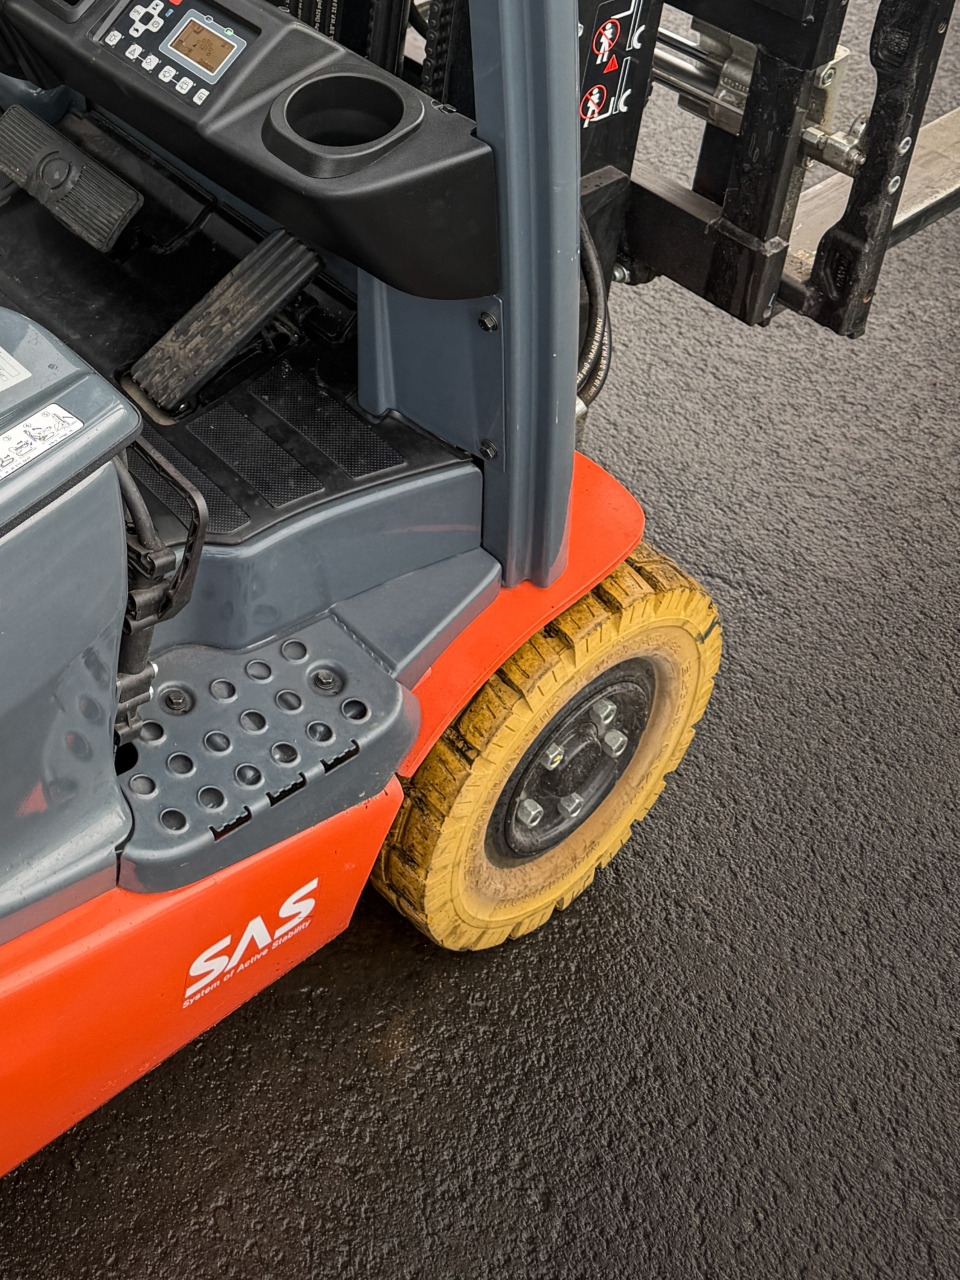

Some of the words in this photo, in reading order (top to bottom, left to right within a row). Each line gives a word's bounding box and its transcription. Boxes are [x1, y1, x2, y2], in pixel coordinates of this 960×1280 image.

[182, 980, 220, 1009] System
[223, 969, 234, 982] of
[237, 949, 269, 973] Active
[271, 919, 311, 950] Stability
[185, 877, 319, 998] SAS
